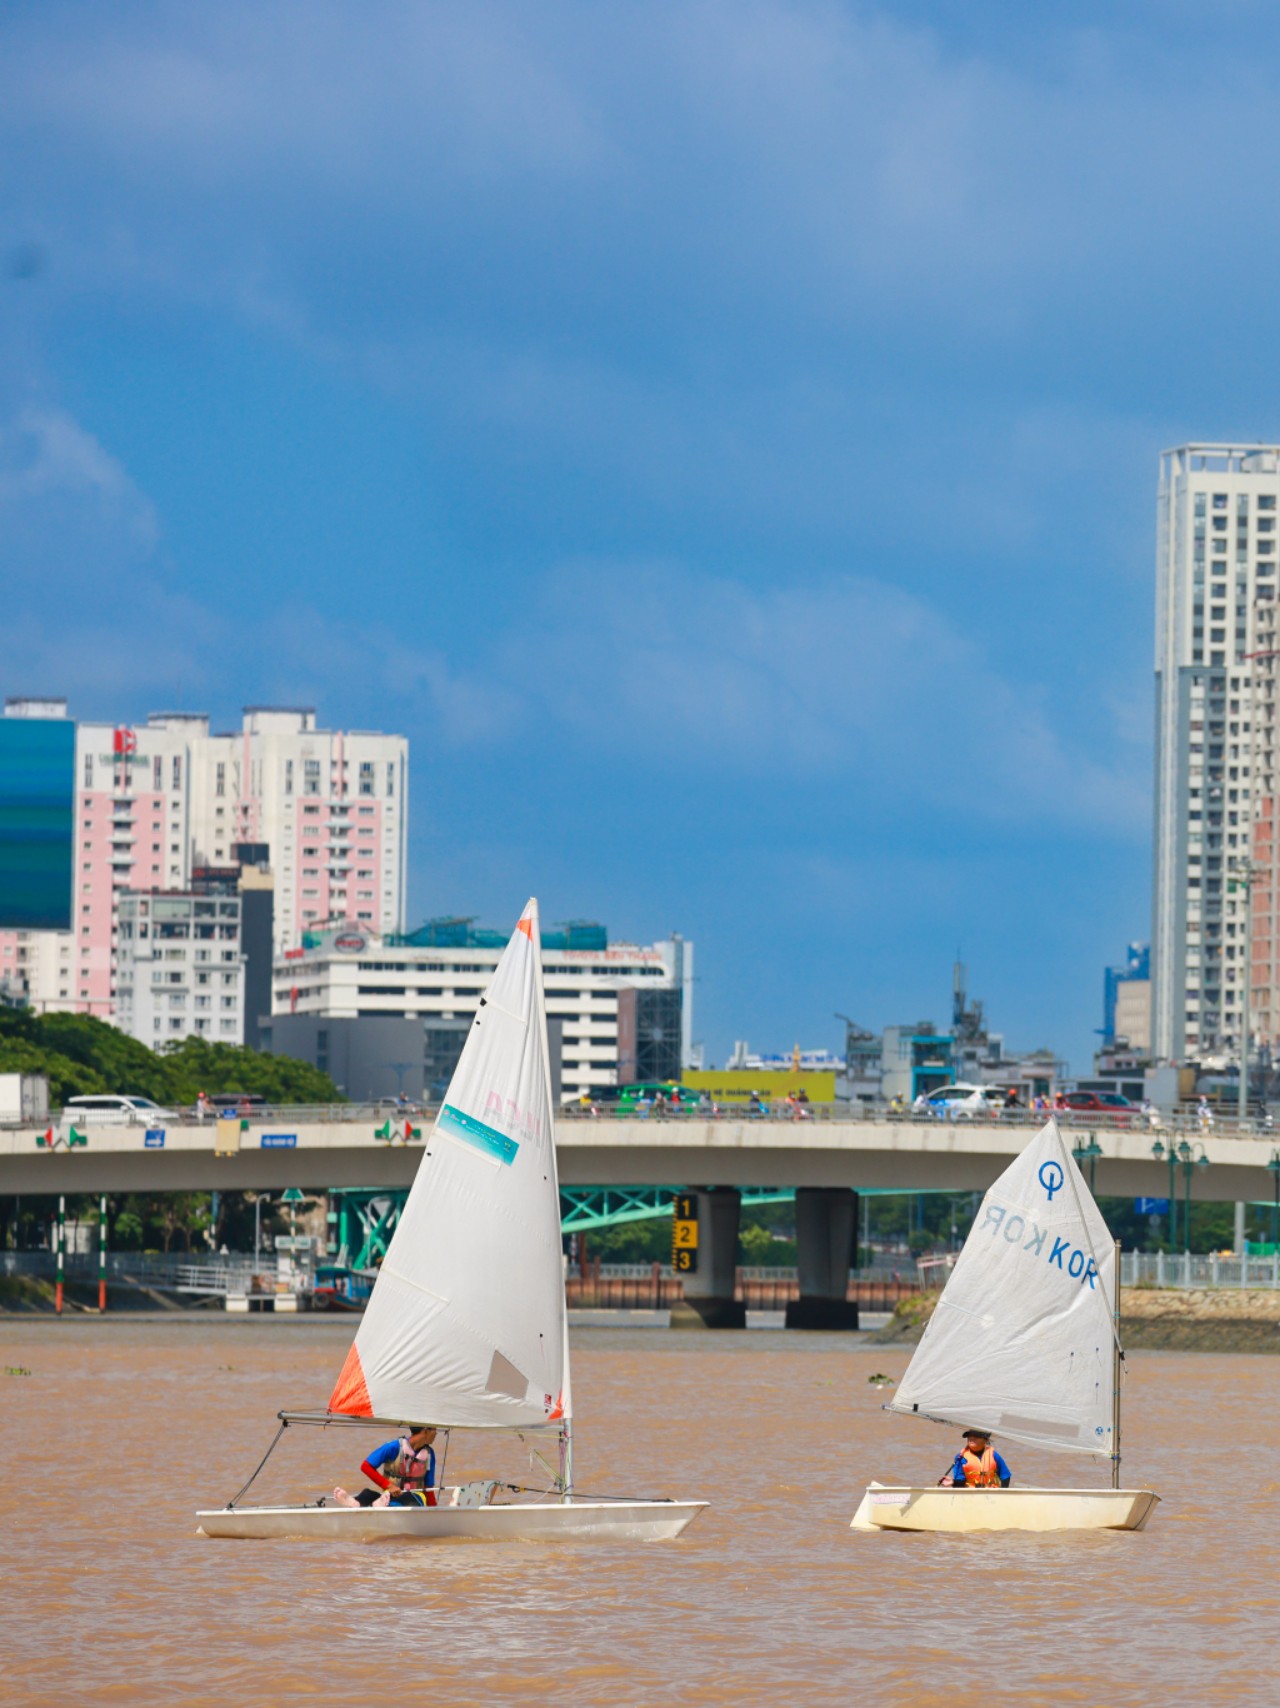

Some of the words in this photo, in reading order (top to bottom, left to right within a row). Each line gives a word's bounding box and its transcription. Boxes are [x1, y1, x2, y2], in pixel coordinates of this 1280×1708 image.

[682, 1199, 690, 1217] 1
[680, 1226, 690, 1243] 2
[679, 1251, 691, 1270] 3
[1048, 1236, 1099, 1290] KOR
